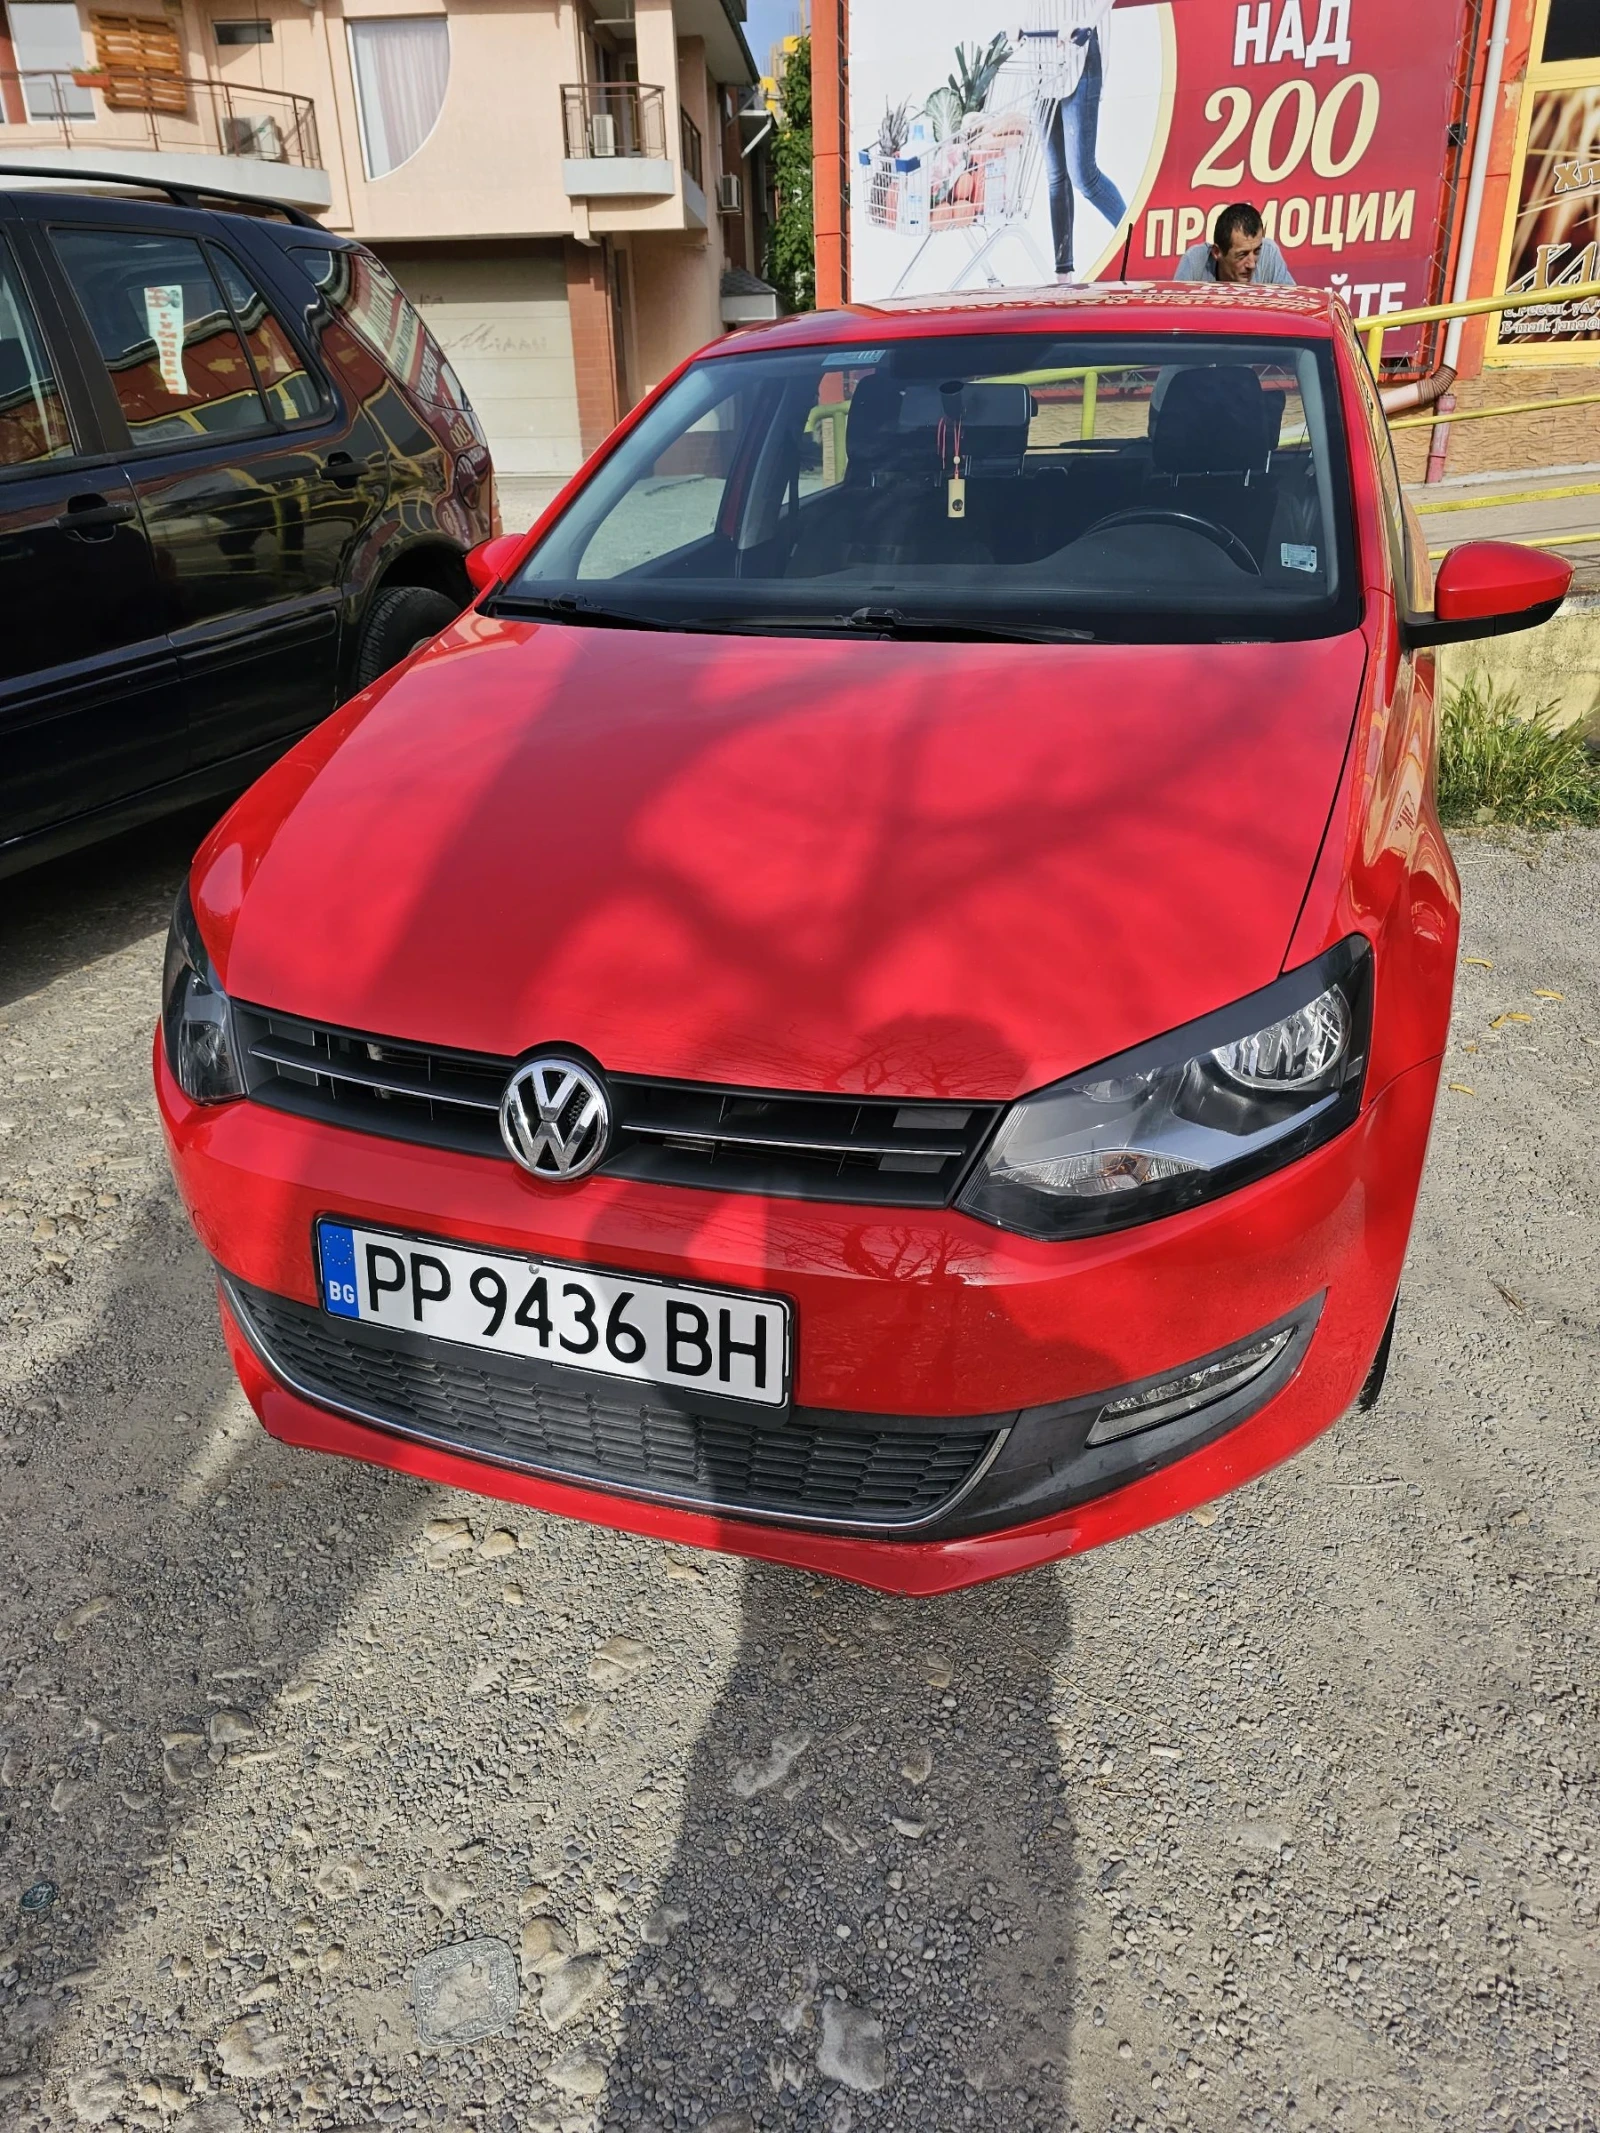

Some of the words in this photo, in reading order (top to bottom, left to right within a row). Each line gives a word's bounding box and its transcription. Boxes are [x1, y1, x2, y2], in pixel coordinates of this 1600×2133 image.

[1233, 0, 1351, 67] НАД
[1191, 73, 1380, 189] 200
[328, 1280, 356, 1304] BG
[365, 1243, 451, 1322] PP
[469, 1266, 647, 1365] 9436
[665, 1299, 768, 1389] BH
